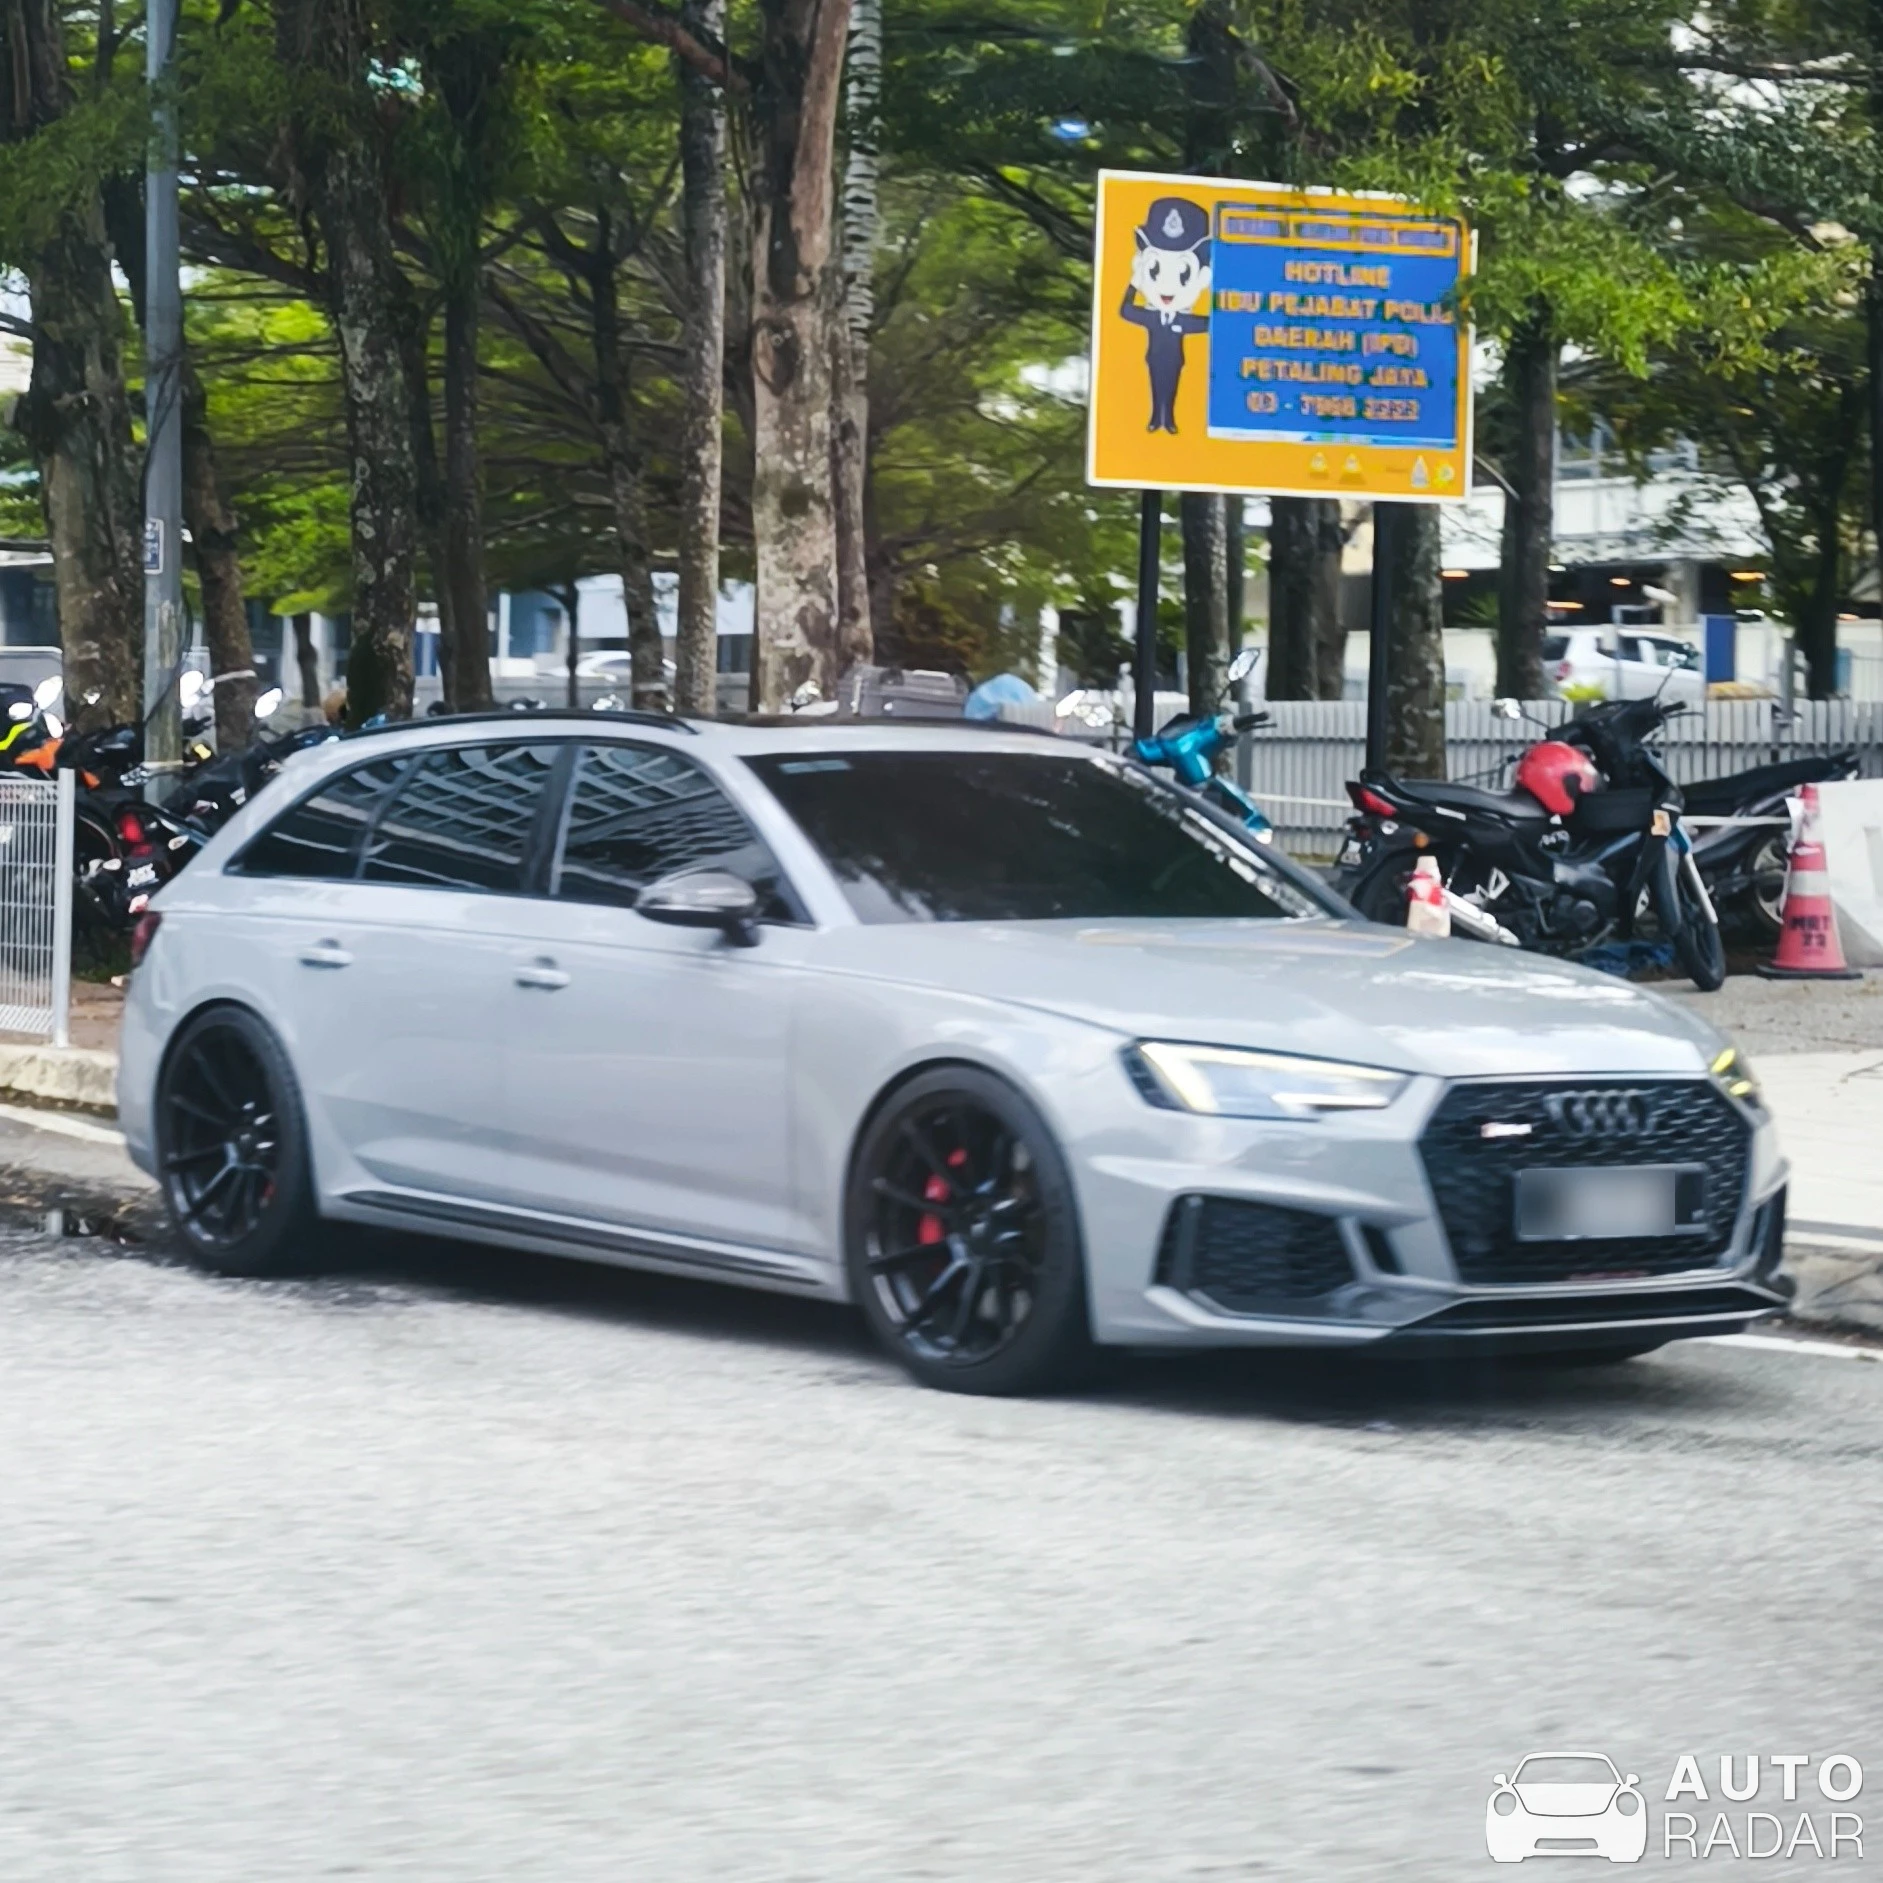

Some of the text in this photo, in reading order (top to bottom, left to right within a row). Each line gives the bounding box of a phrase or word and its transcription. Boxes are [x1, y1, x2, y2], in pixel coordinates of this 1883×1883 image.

[1285, 261, 1391, 288] HOTLINE
[1219, 289, 1261, 313] IBU
[1268, 291, 1377, 319] PEJABAT
[1253, 326, 1355, 350] DAERAH
[1241, 357, 1428, 388] PETALING JAYA
[1247, 391, 1278, 413] 03
[1790, 915, 1829, 931] MRT
